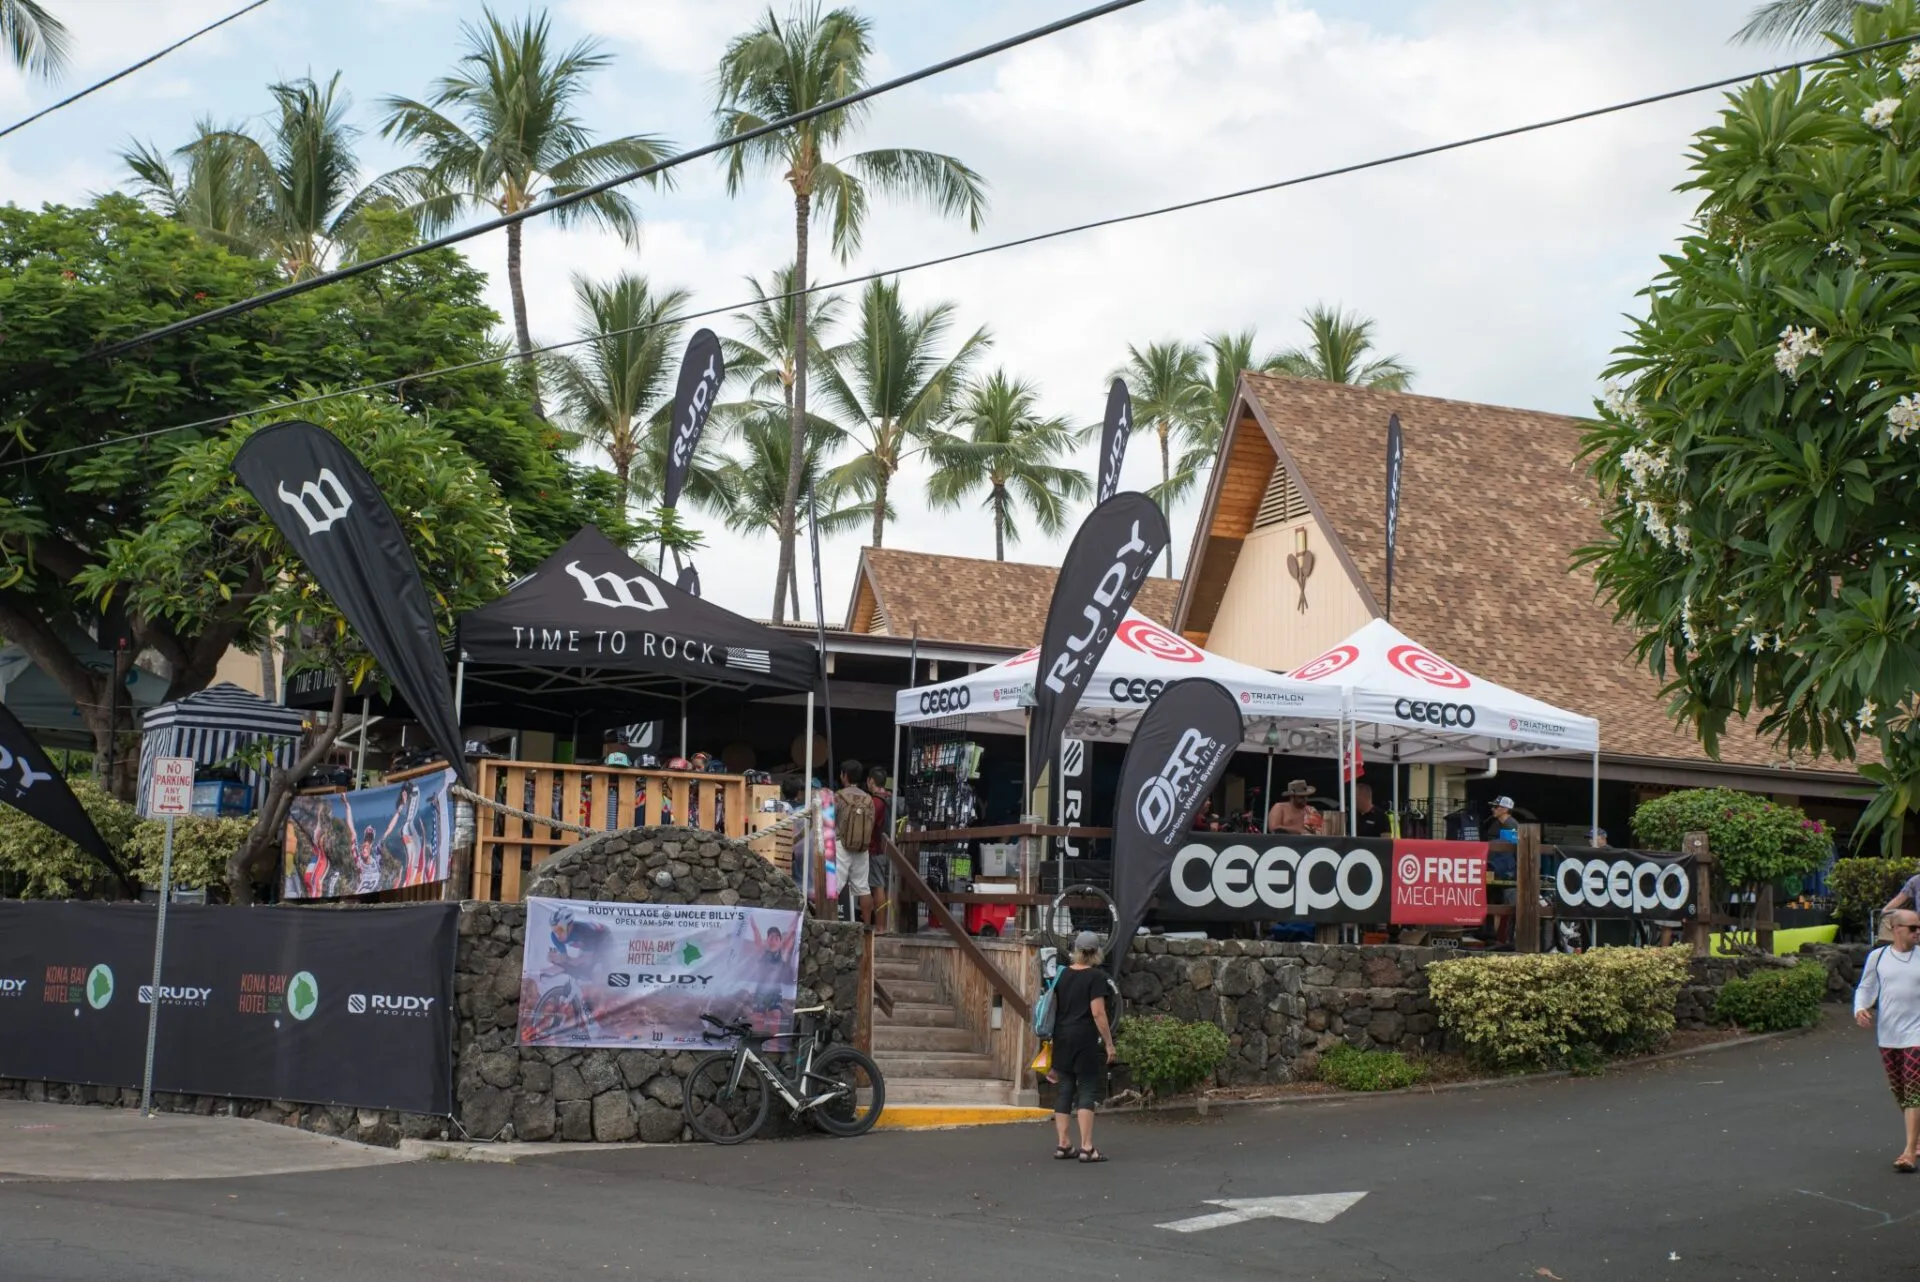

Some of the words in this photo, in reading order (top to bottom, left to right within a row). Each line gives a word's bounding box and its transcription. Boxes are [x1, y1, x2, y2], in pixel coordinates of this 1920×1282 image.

[673, 354, 716, 468] RUDY
[1100, 403, 1127, 503] RUDY
[1045, 519, 1145, 694] RUDY
[1073, 545, 1153, 687] PROJECT
[512, 626, 580, 652] TIME
[596, 630, 627, 655] TO
[643, 633, 716, 665] ROCK
[1000, 687, 1022, 695] TRIATH
[1109, 677, 1165, 703] CEE
[1250, 692, 1304, 702] TRIATHLON
[1519, 719, 1566, 732] TRIATHLON
[167, 763, 182, 774] NO
[156, 774, 191, 786] PARKING
[163, 795, 181, 803] TIME
[1164, 811, 1187, 845] Carbon
[1184, 783, 1204, 810] Wheel
[1199, 743, 1227, 782] Systems
[1065, 789, 1082, 857] RU
[1397, 886, 1483, 907] MECHANIC
[588, 906, 615, 916] RUDY
[617, 908, 659, 918] VILLAGE
[662, 910, 672, 920] @
[674, 911, 706, 920] UNCLE
[709, 911, 745, 921] BILLY'S
[615, 918, 636, 926] OPEN
[678, 920, 699, 928] COME
[629, 939, 654, 952] KONA
[657, 940, 676, 952] BAY
[628, 953, 656, 965] HOTEL
[46, 966, 68, 984] KONA
[70, 967, 87, 985] BAY
[637, 973, 714, 985] RUDY
[0, 979, 27, 991] DY
[240, 973, 266, 993] KONA
[268, 974, 287, 994] BAY
[44, 985, 69, 1004] HOTEL
[159, 986, 212, 1000] RUDY
[239, 994, 268, 1014] HOTEL
[371, 995, 435, 1011] RUDY
[375, 1009, 430, 1017] PROJECT
